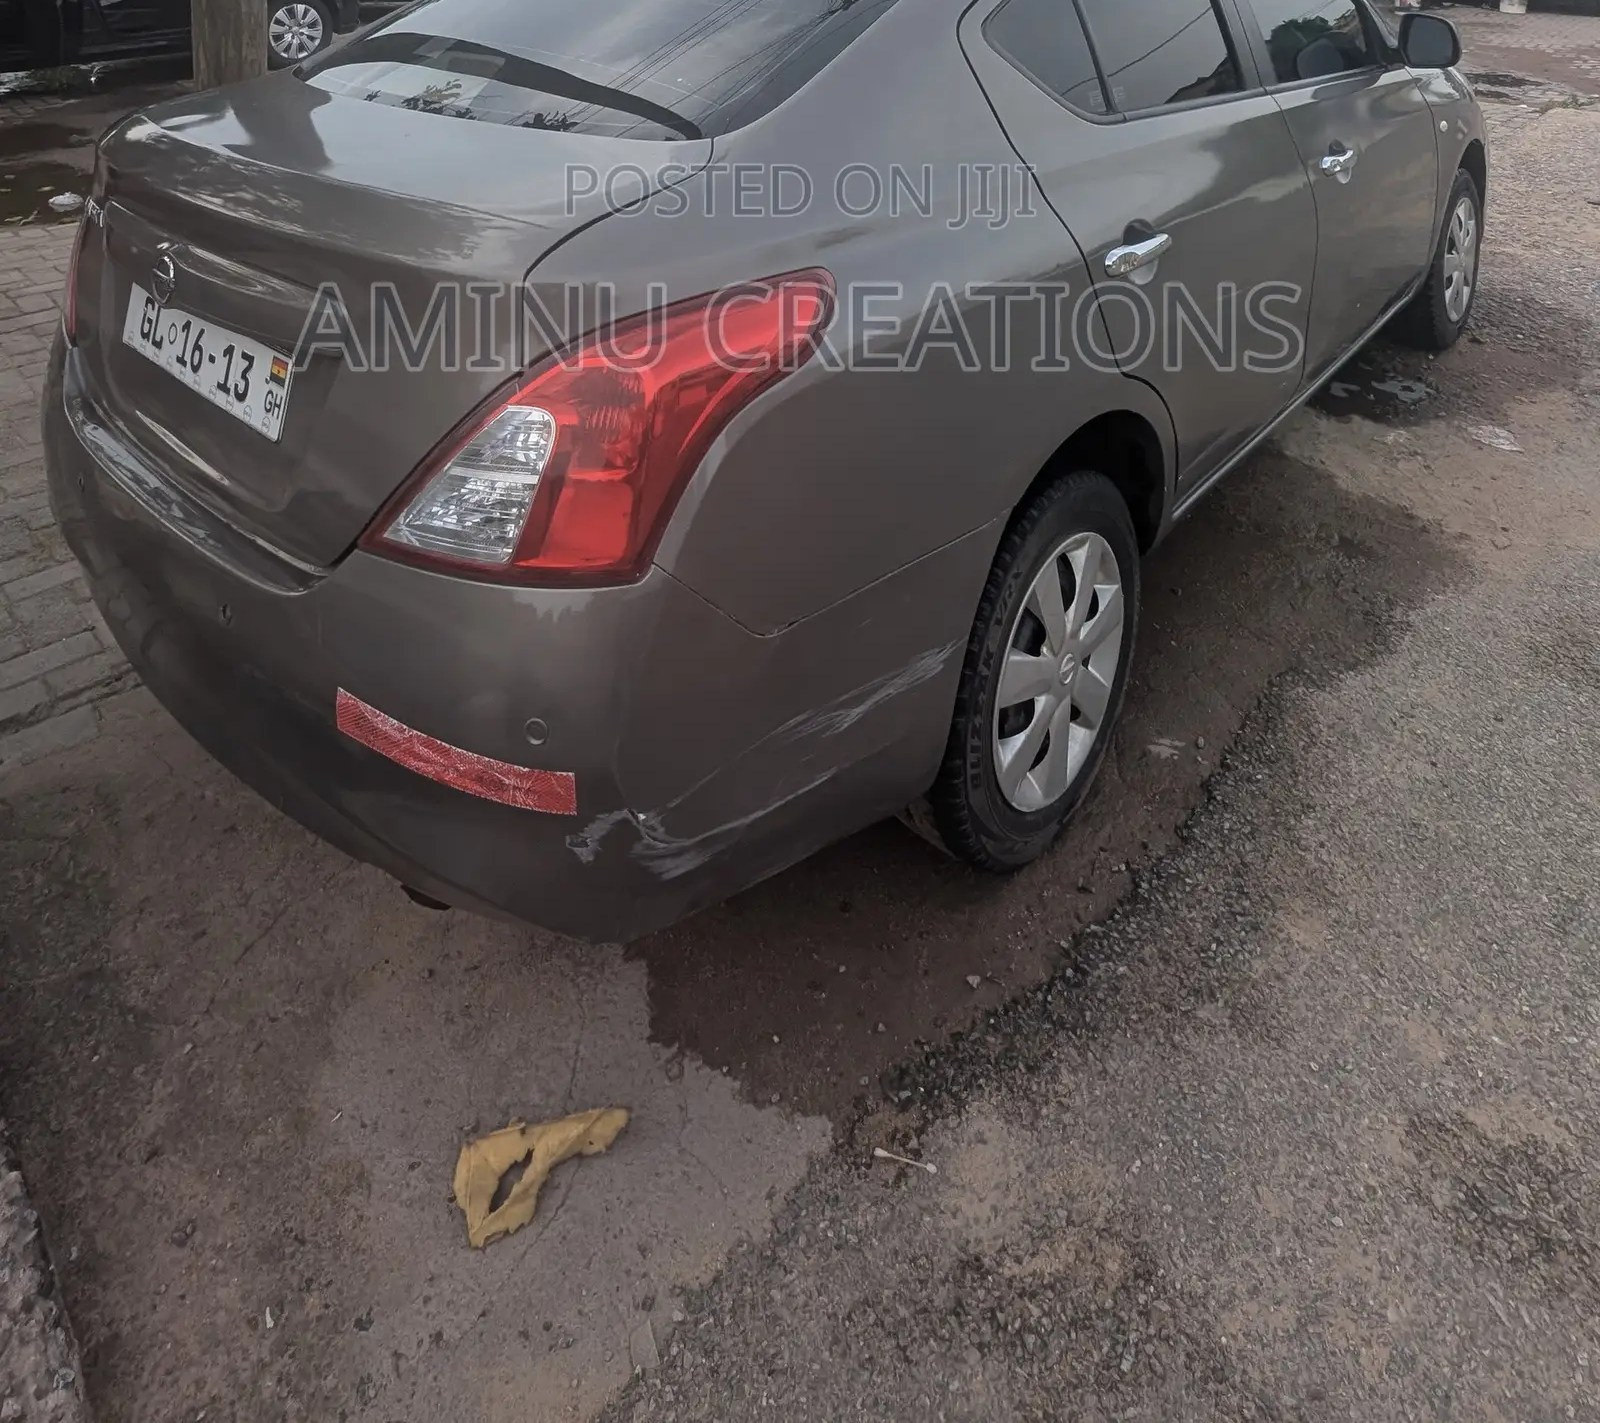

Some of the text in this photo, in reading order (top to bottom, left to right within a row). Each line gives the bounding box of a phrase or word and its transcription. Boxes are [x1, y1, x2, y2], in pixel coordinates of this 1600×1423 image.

[140, 295, 256, 403] GL 16-13
[264, 389, 284, 420] GH
